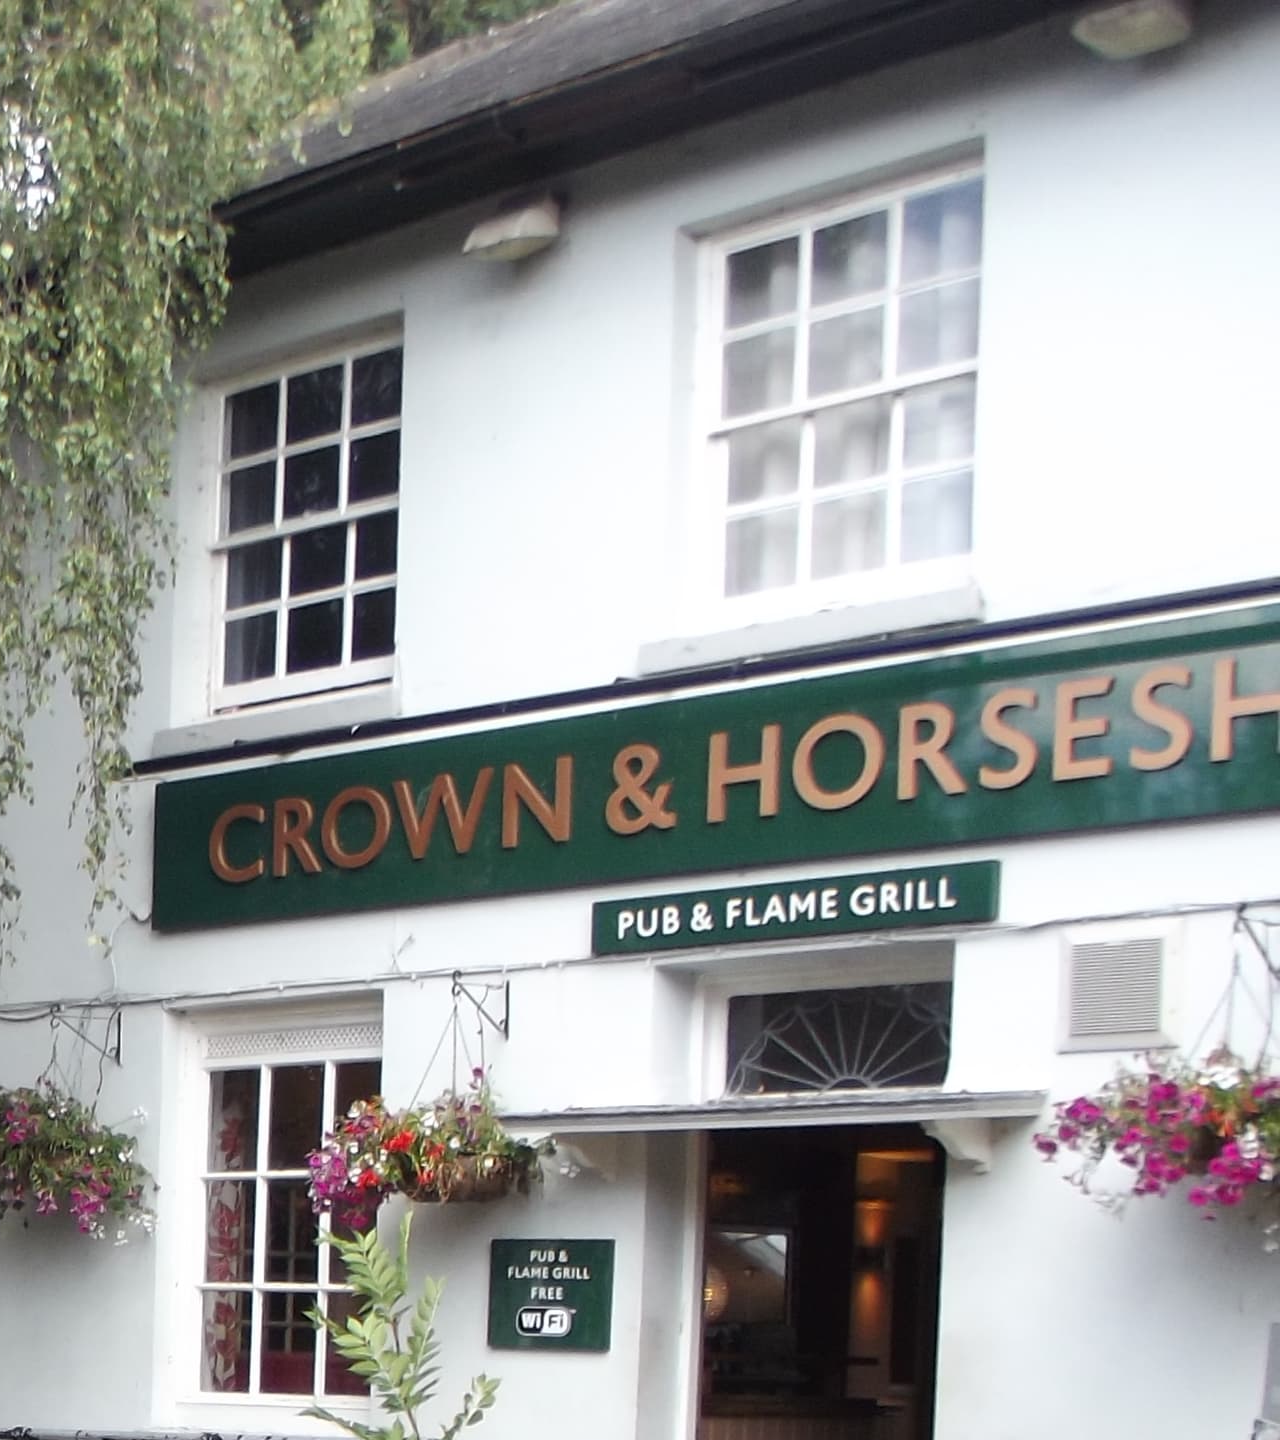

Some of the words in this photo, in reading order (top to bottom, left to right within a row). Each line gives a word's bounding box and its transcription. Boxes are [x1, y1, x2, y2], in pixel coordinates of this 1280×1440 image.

[209, 755, 574, 884] CROWN
[606, 743, 678, 836] &
[705, 657, 1280, 824] HORSESH
[617, 908, 681, 940] PUB
[690, 902, 714, 933] &
[725, 889, 839, 929] FLAME
[849, 877, 957, 917] GRILL
[529, 1249, 555, 1263] PUB
[558, 1250, 569, 1263] &
[507, 1266, 550, 1279] FLAME
[552, 1267, 591, 1280] GRILL
[530, 1287, 564, 1300] FREE
